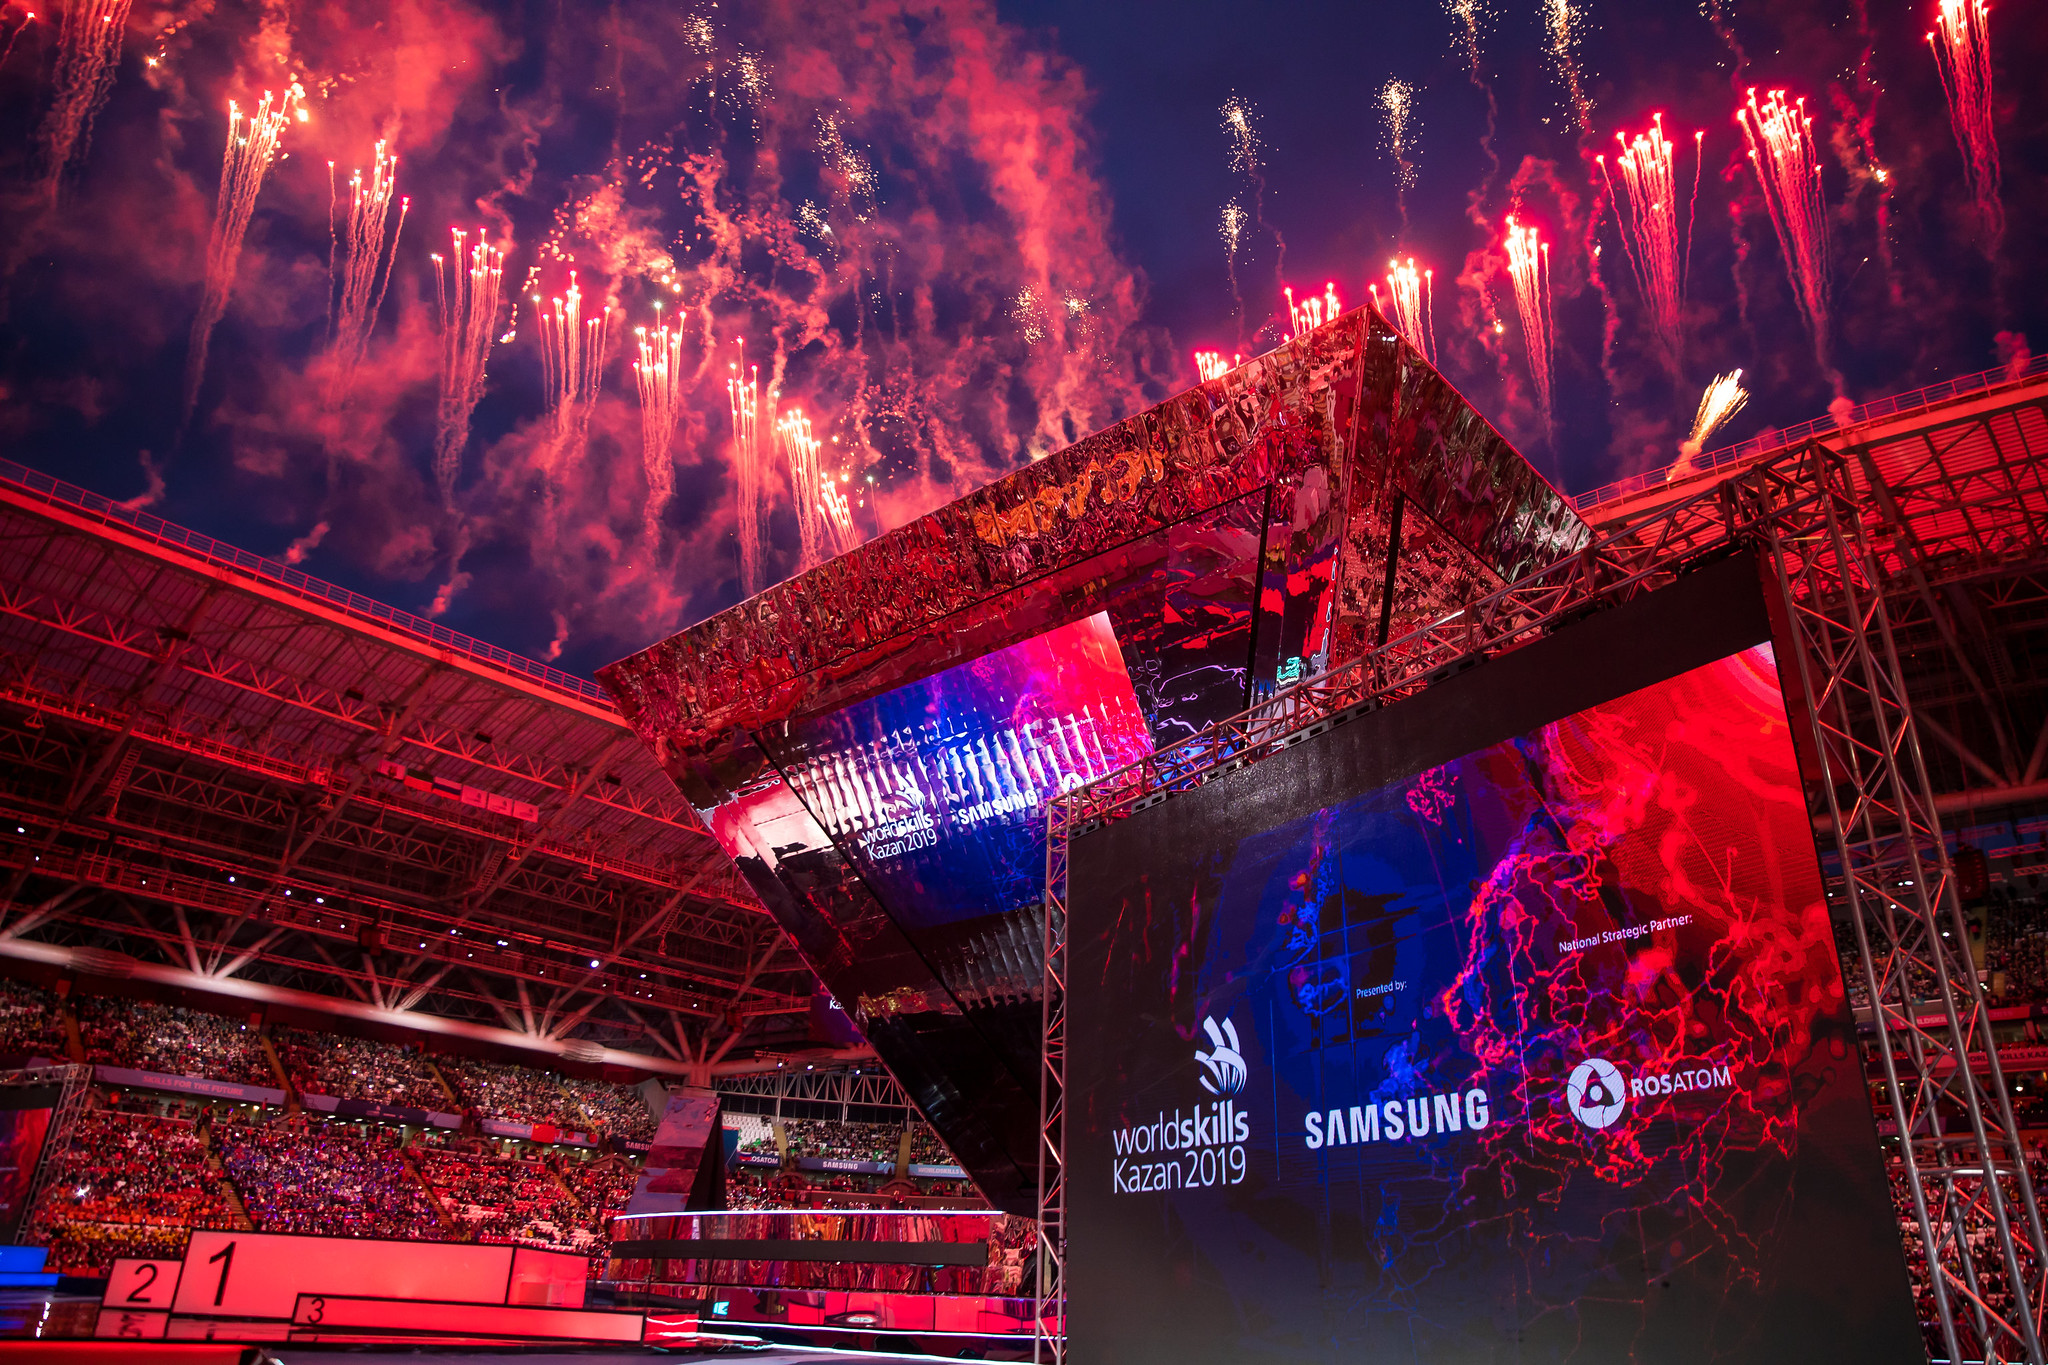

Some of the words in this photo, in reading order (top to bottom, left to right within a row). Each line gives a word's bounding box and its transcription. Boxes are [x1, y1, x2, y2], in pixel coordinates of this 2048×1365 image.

[958, 789, 1038, 825] SAMSUNG
[866, 840, 907, 861] Kazan
[904, 828, 937, 852] 2019
[1558, 932, 1601, 953] National
[1602, 923, 1649, 943] Strategic
[1650, 914, 1693, 933] Partner:
[1356, 981, 1394, 999] Presented
[1395, 980, 1408, 992] by:
[174, 1080, 192, 1089] FOR
[194, 1082, 210, 1092] THE
[211, 1085, 244, 1096] FUTURE
[1631, 1066, 1732, 1098] ROSATOM
[1113, 1099, 1250, 1156] worldskills
[1305, 1088, 1490, 1150] SAMSUNG
[625, 1141, 652, 1151] SAMSU
[751, 1156, 779, 1165] OSATOM
[822, 1160, 859, 1170] SAMSUNG
[1113, 1158, 1181, 1194] Kazan
[1185, 1145, 1247, 1188] 2019
[126, 1263, 158, 1303] 2
[208, 1241, 236, 1306] 1
[307, 1297, 325, 1324] 3
